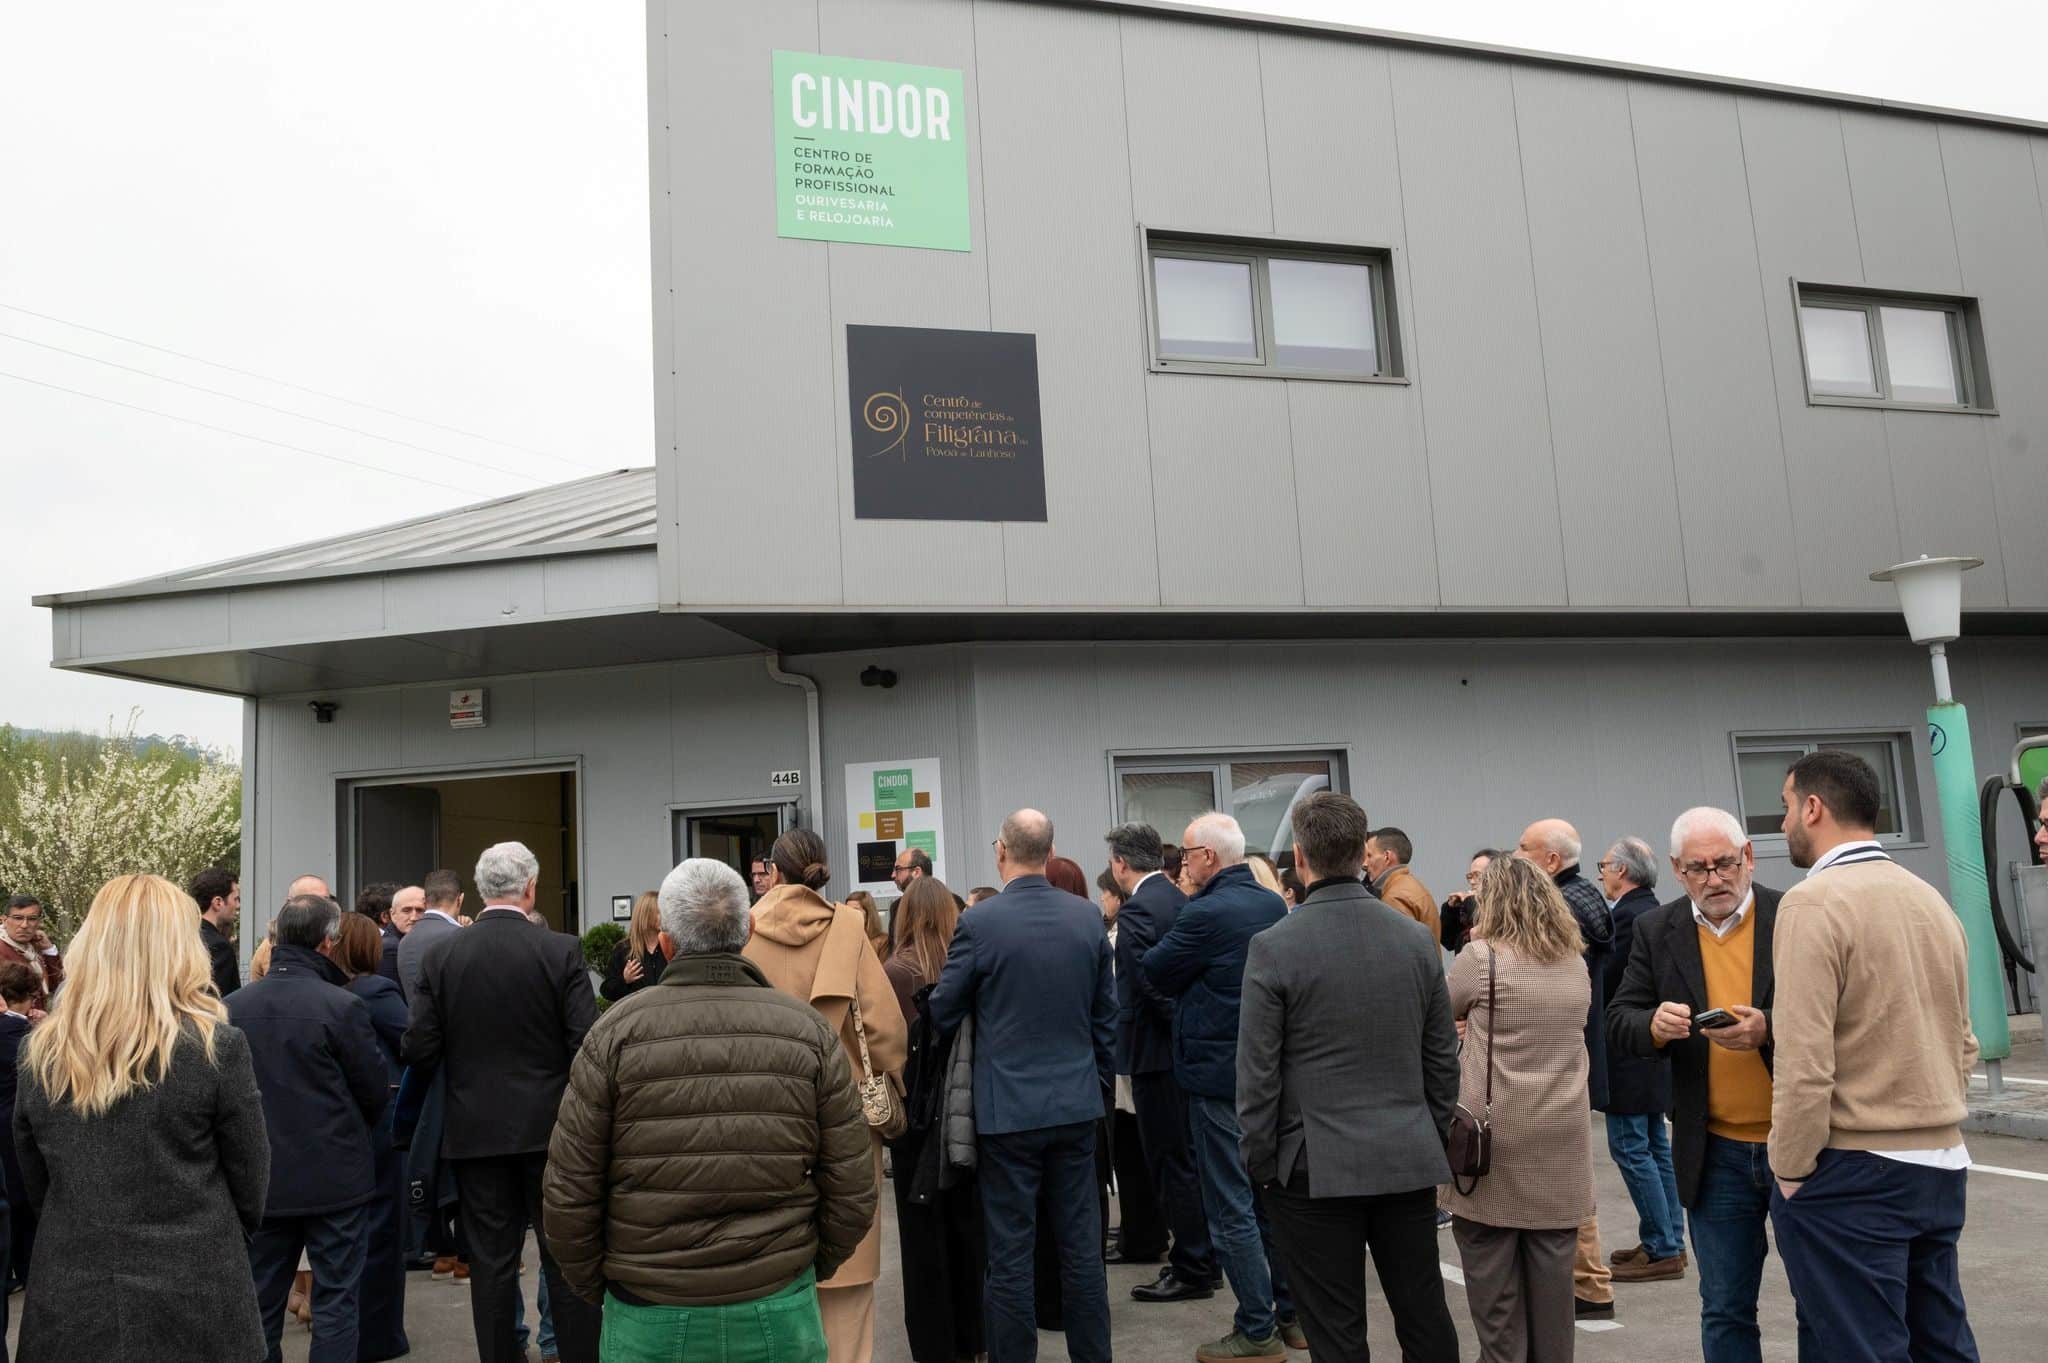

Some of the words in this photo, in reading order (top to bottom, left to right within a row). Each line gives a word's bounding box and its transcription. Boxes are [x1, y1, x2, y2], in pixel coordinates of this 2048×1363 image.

[791, 72, 952, 141] CINDOR
[794, 147, 850, 162] CENTRO
[855, 152, 873, 164] DE
[794, 162, 874, 180] FORMAÇÃO
[795, 178, 896, 197] PROFISSIONAL
[795, 194, 889, 212] OURIVESARIA
[797, 208, 806, 221] E
[809, 209, 895, 228] RELOJOARIA
[923, 393, 969, 408] Centro
[924, 422, 1017, 448] Filigrana
[772, 772, 800, 785] 44B
[878, 774, 909, 788] CINDOR
